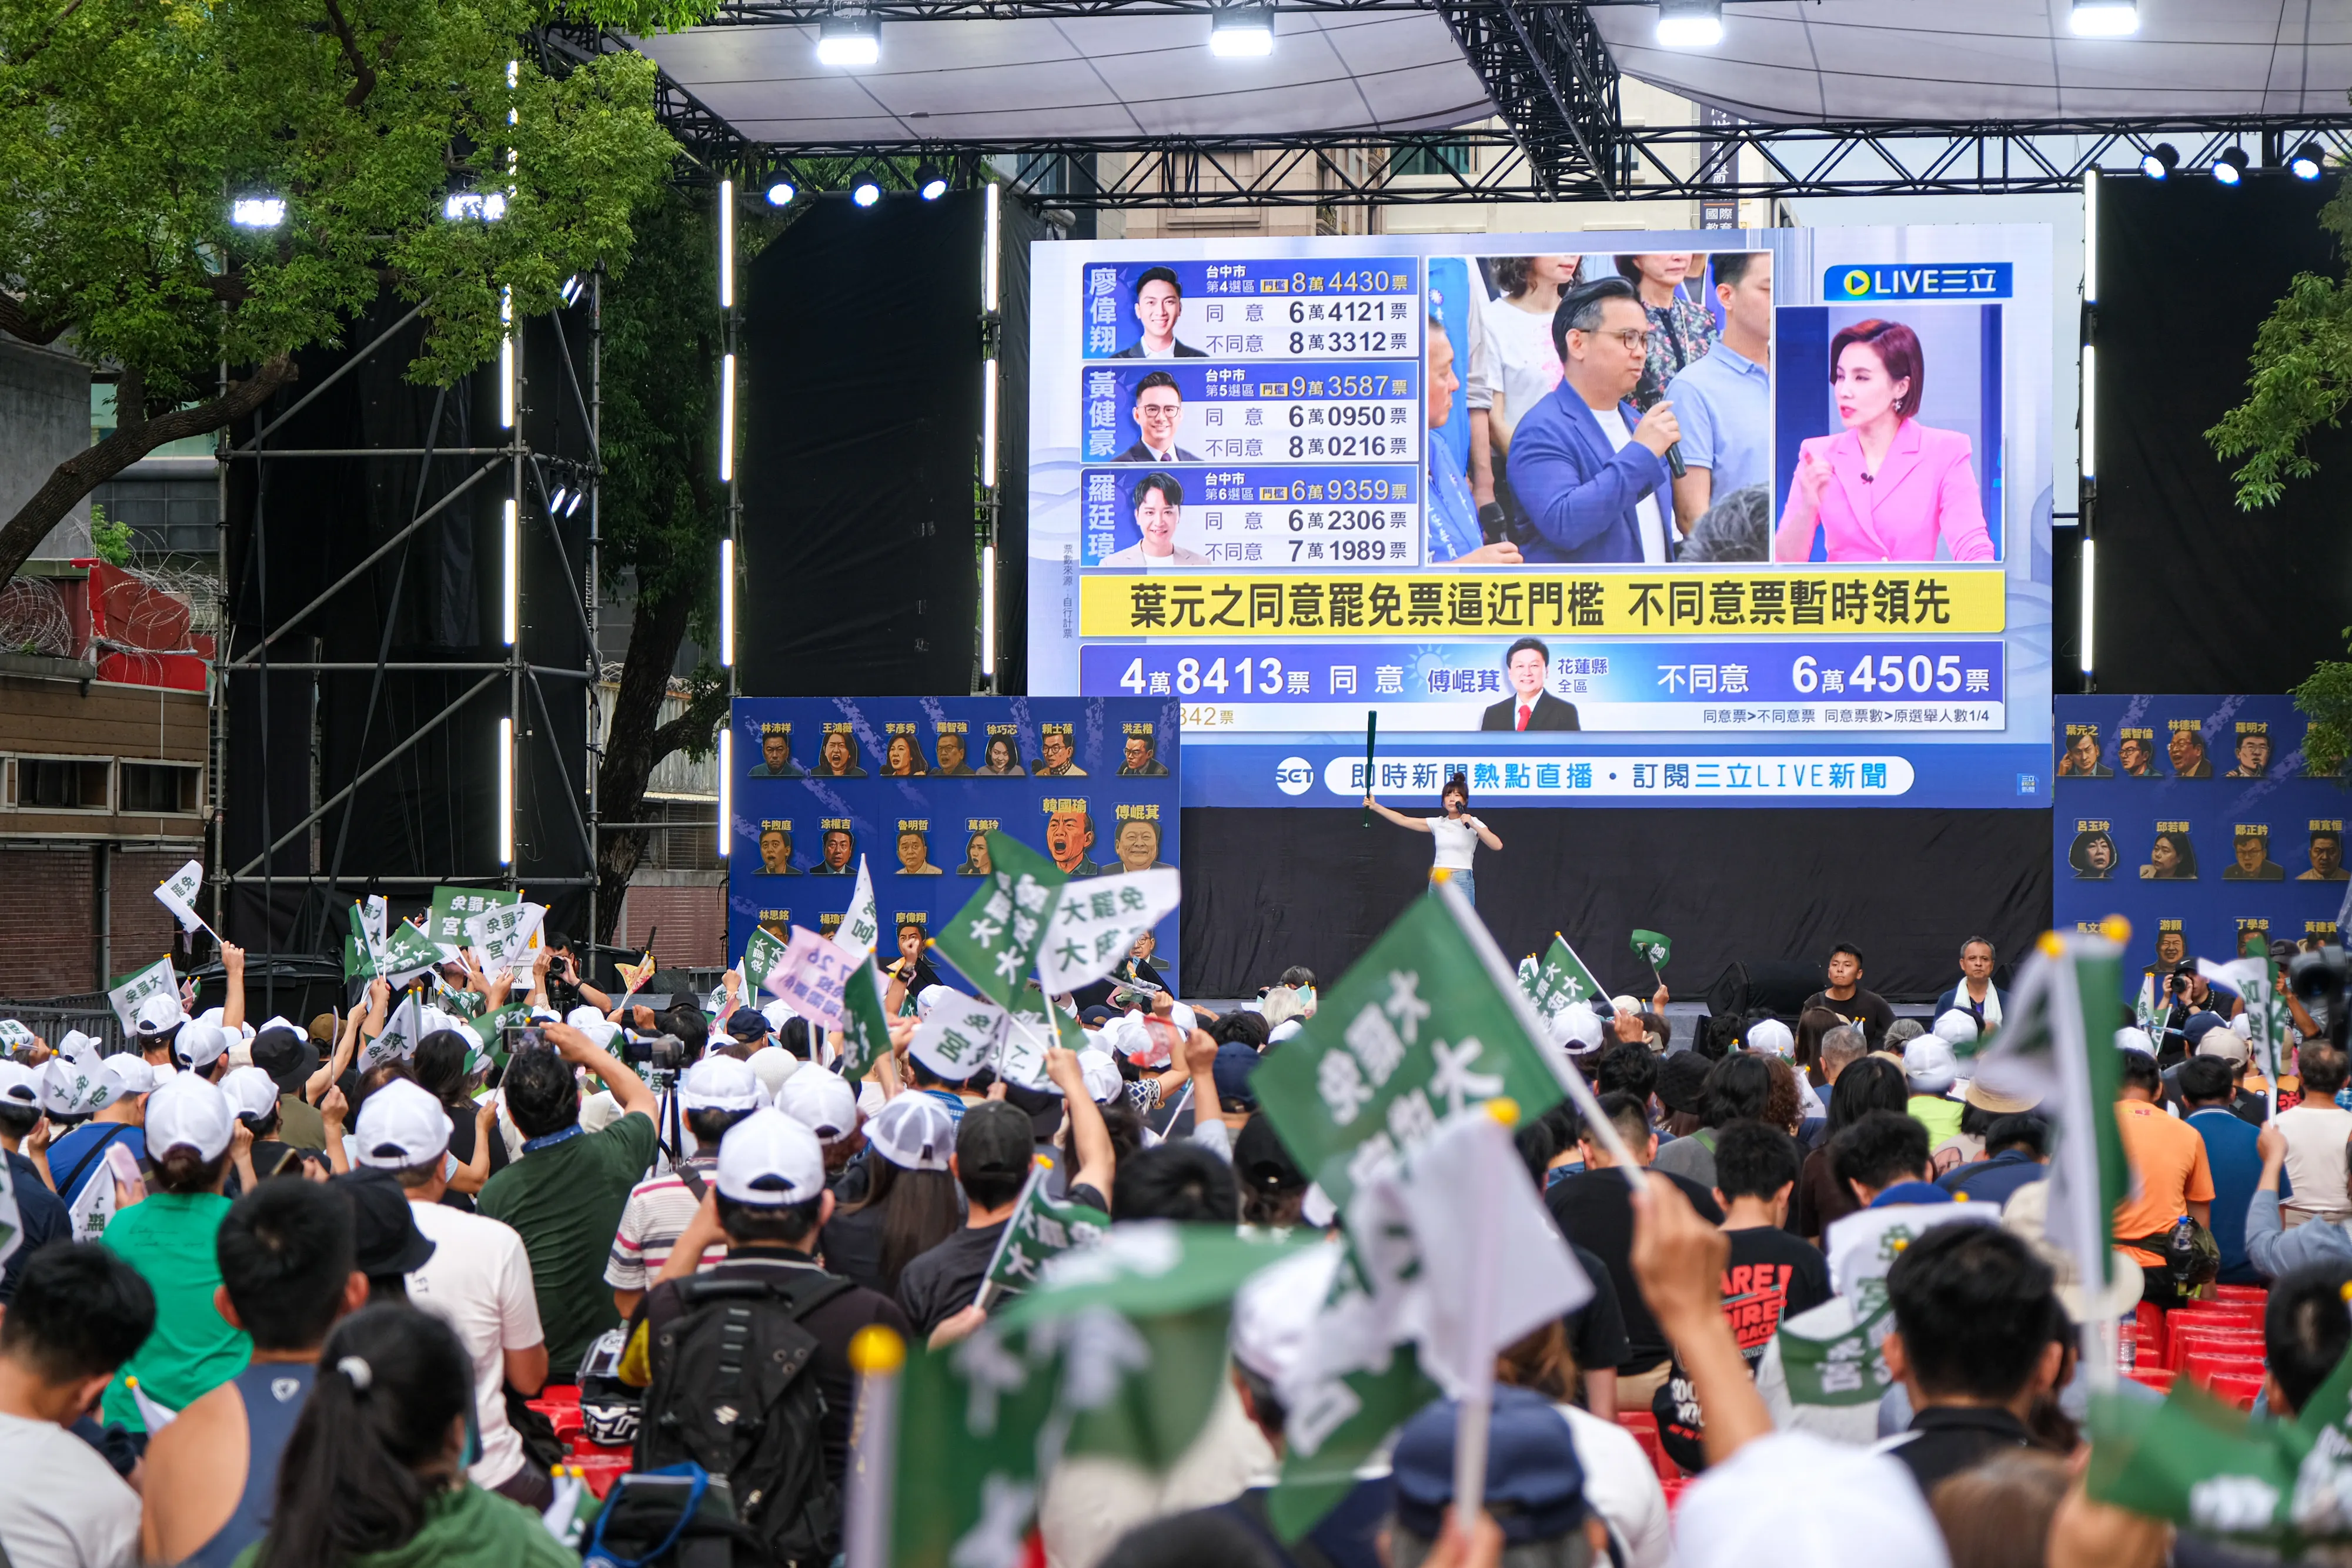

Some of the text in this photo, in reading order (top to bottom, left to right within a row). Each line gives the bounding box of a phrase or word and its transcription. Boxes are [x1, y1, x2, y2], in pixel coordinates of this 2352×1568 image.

[1706, 208, 1732, 219] 國際
[1206, 265, 1246, 278] 台中市
[1207, 280, 1254, 293] 第4選區
[1262, 280, 1288, 292] 門檻
[1089, 268, 1117, 353] 廖偉翔
[1206, 335, 1263, 353] 不同意
[1205, 369, 1245, 382] 台中市
[1206, 384, 1254, 397] 第5選區
[1261, 384, 1288, 396] 門檻
[1088, 370, 1117, 457] 黃健豪
[1206, 439, 1262, 457] 不同意
[1205, 473, 1245, 486] 台中市
[1205, 487, 1254, 500] 第6選區
[1261, 488, 1288, 500] 門檻
[1088, 474, 1115, 558] 羅廷瑋
[1205, 543, 1262, 561] 不同意
[1131, 579, 1950, 628] 葉元之同意罷免票逼近門檻 不同意票暫時領先
[1557, 657, 1608, 676] 花蓮縣
[1658, 663, 1749, 694] 不同意
[1558, 678, 1588, 693] 全區
[823, 722, 853, 733] 王鴻薇
[886, 723, 916, 734] 李彥秀
[937, 722, 967, 733] 羅智強
[987, 724, 1018, 735] 徐巧芯
[1042, 724, 1073, 734] 賴士葆
[1122, 724, 1153, 734] 洪孟楷
[2066, 724, 2098, 735] 葉元之
[2168, 720, 2201, 731] 林德福
[2235, 722, 2268, 733] 羅明才
[1043, 798, 1087, 813] 韓國瑜
[821, 819, 851, 830] 涂權吉
[898, 820, 928, 831] 魯明哲
[968, 820, 999, 830] 萬美玲
[759, 910, 789, 921] 林思銘
[896, 912, 927, 923] 廖偉翔
